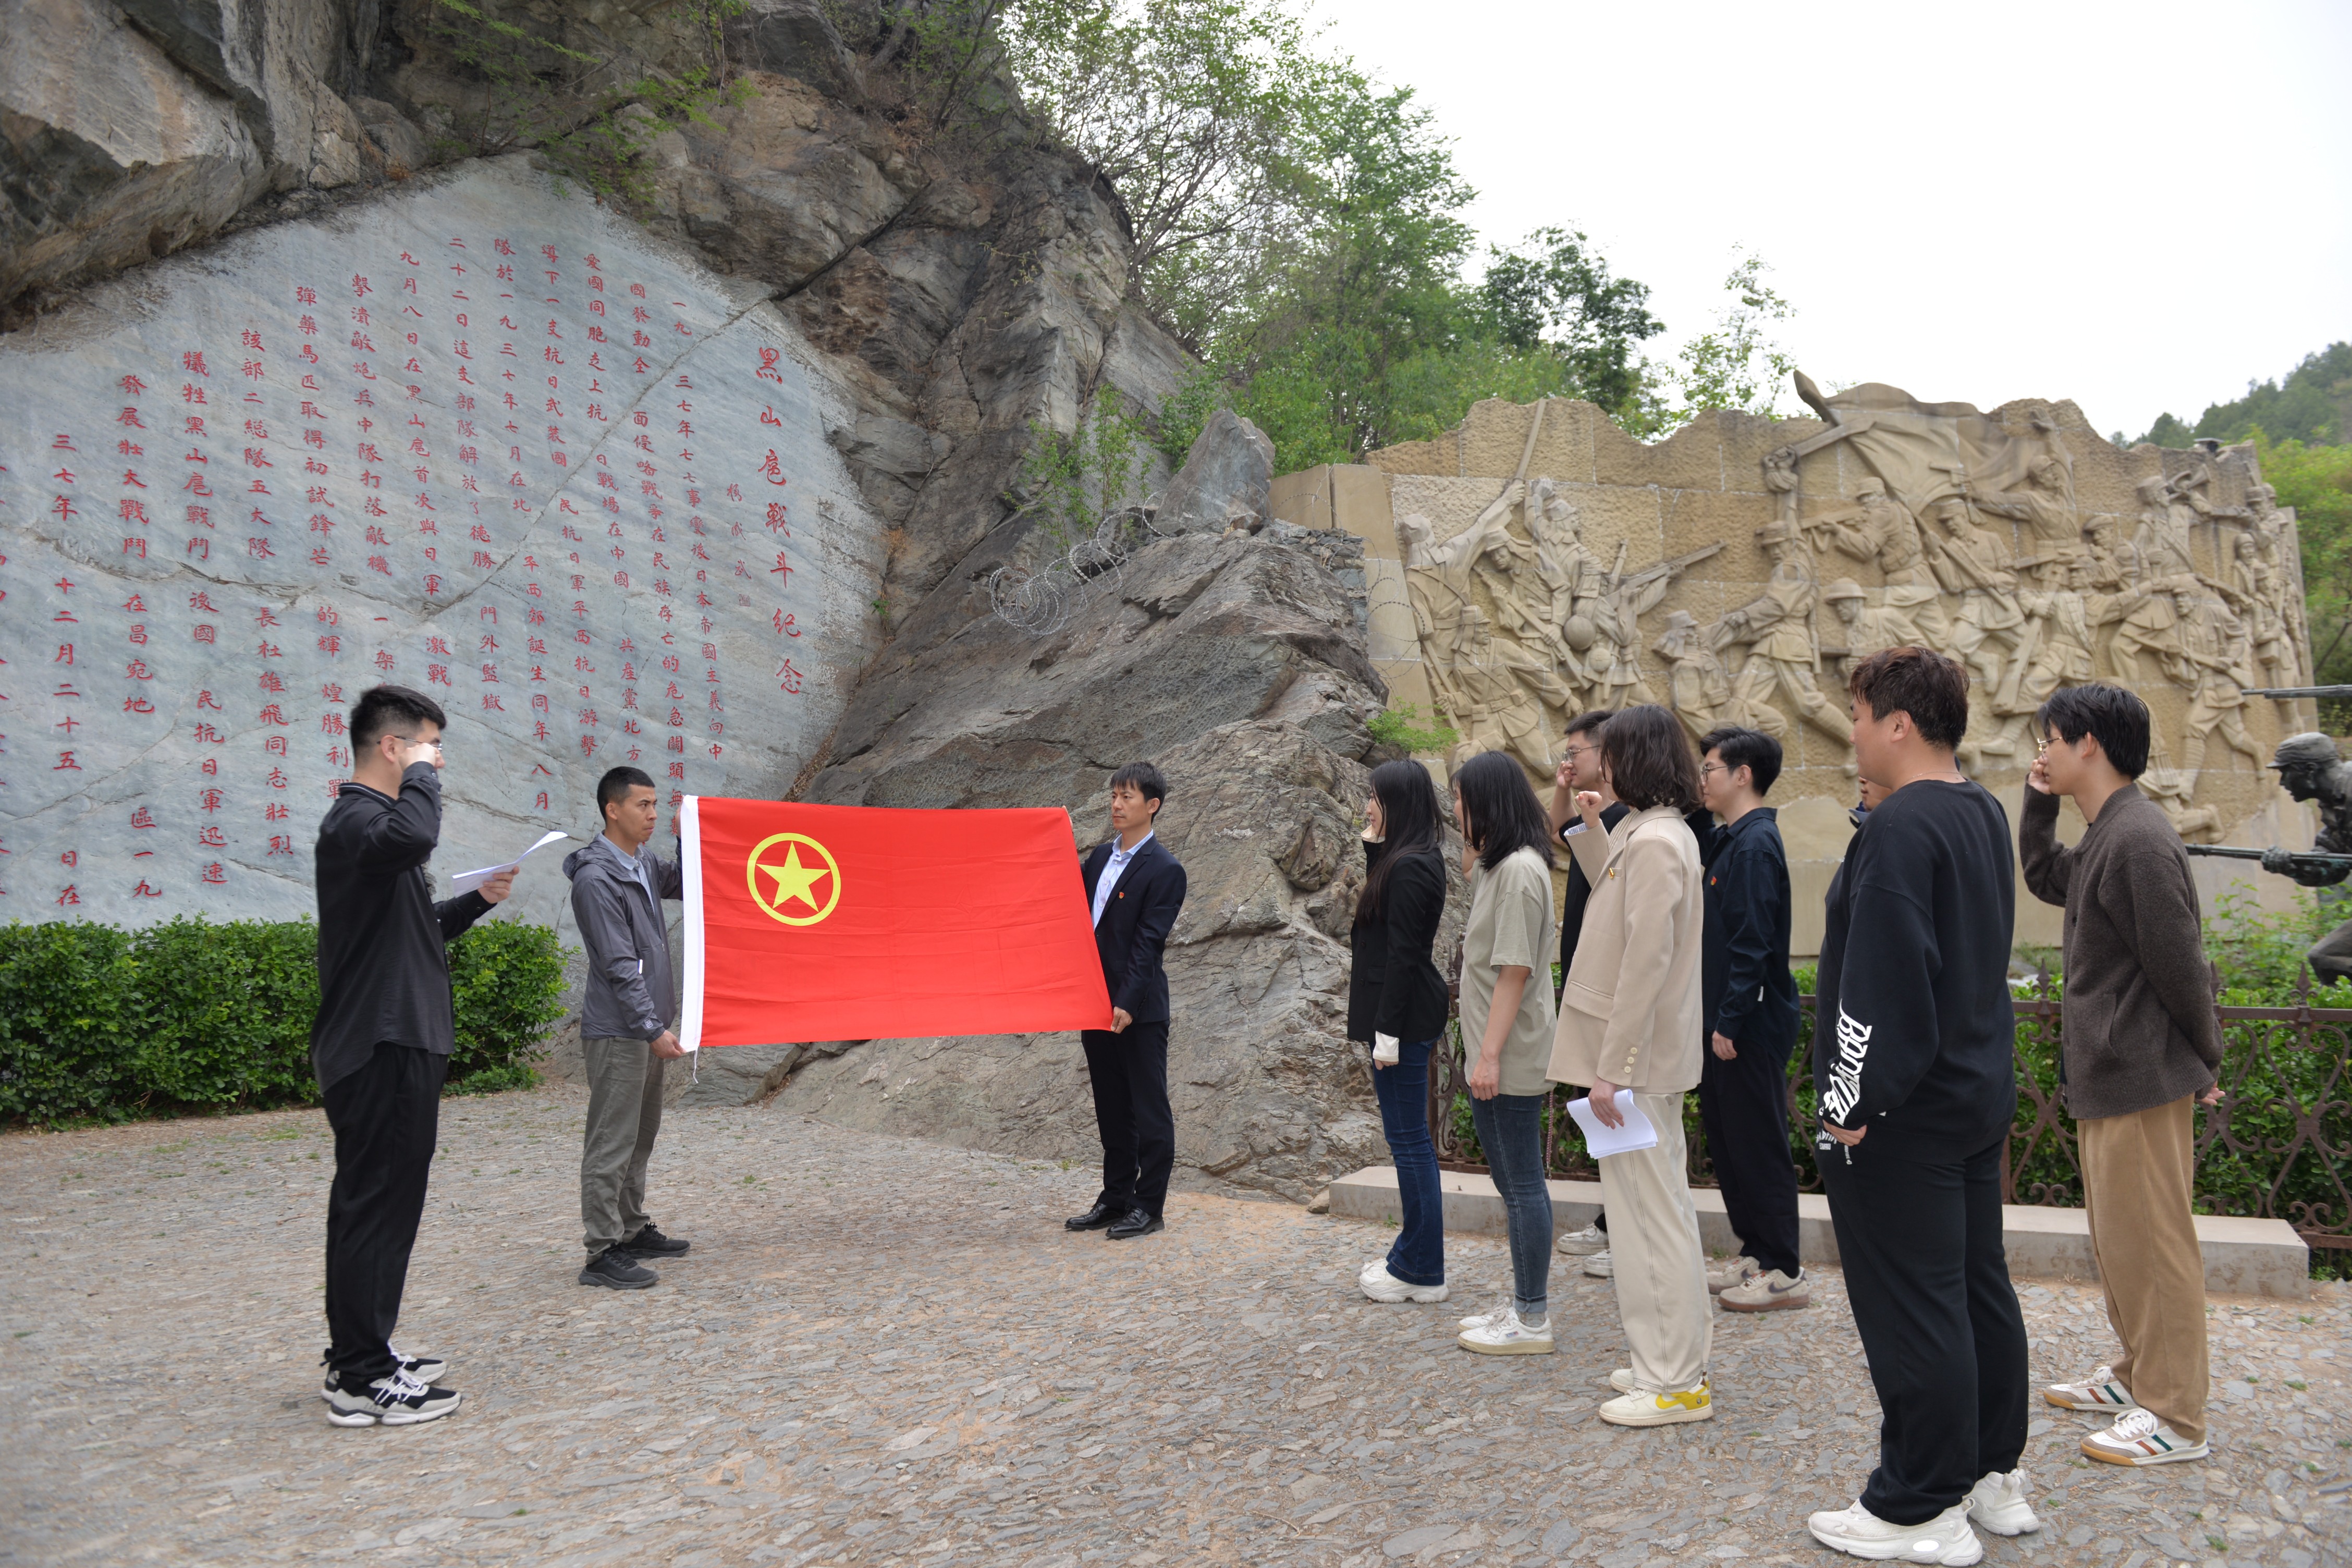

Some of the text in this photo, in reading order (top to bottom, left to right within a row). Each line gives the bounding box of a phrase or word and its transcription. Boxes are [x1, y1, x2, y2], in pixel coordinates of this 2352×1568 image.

[350, 273, 395, 687] 擊潰敵炮兵中隊打落敵機一架
